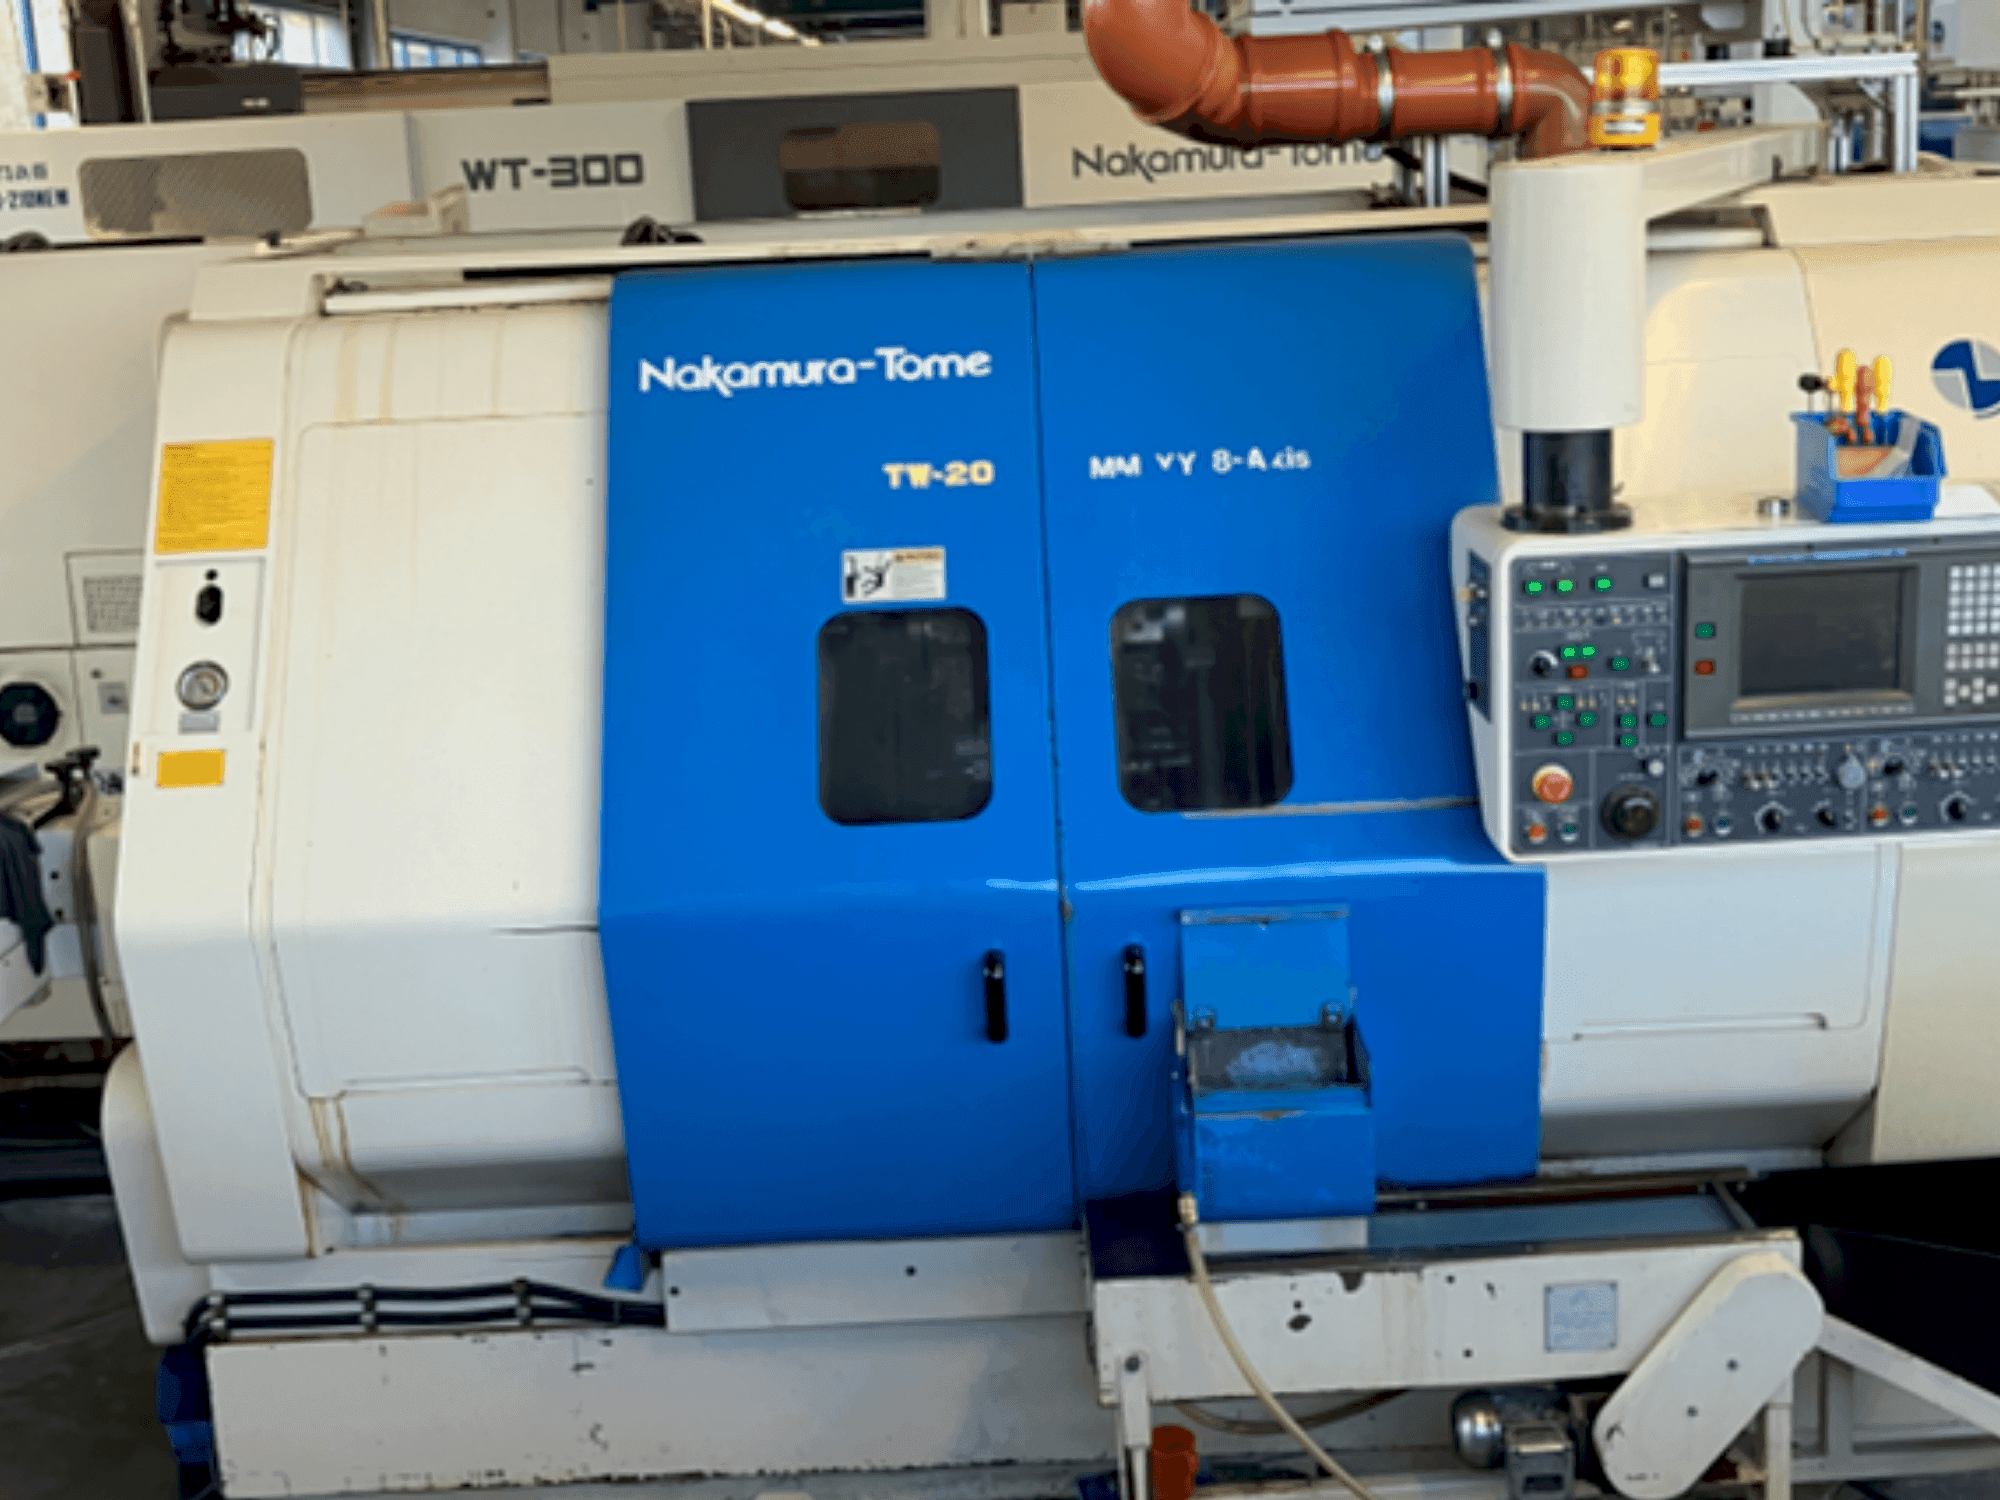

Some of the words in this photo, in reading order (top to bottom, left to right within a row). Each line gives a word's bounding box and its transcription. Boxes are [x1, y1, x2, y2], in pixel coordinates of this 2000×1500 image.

[461, 153, 645, 191] WT-300
[638, 346, 991, 398] Nakamura-Tome
[881, 460, 995, 490] TW-20
[1089, 453, 1142, 480] MM
